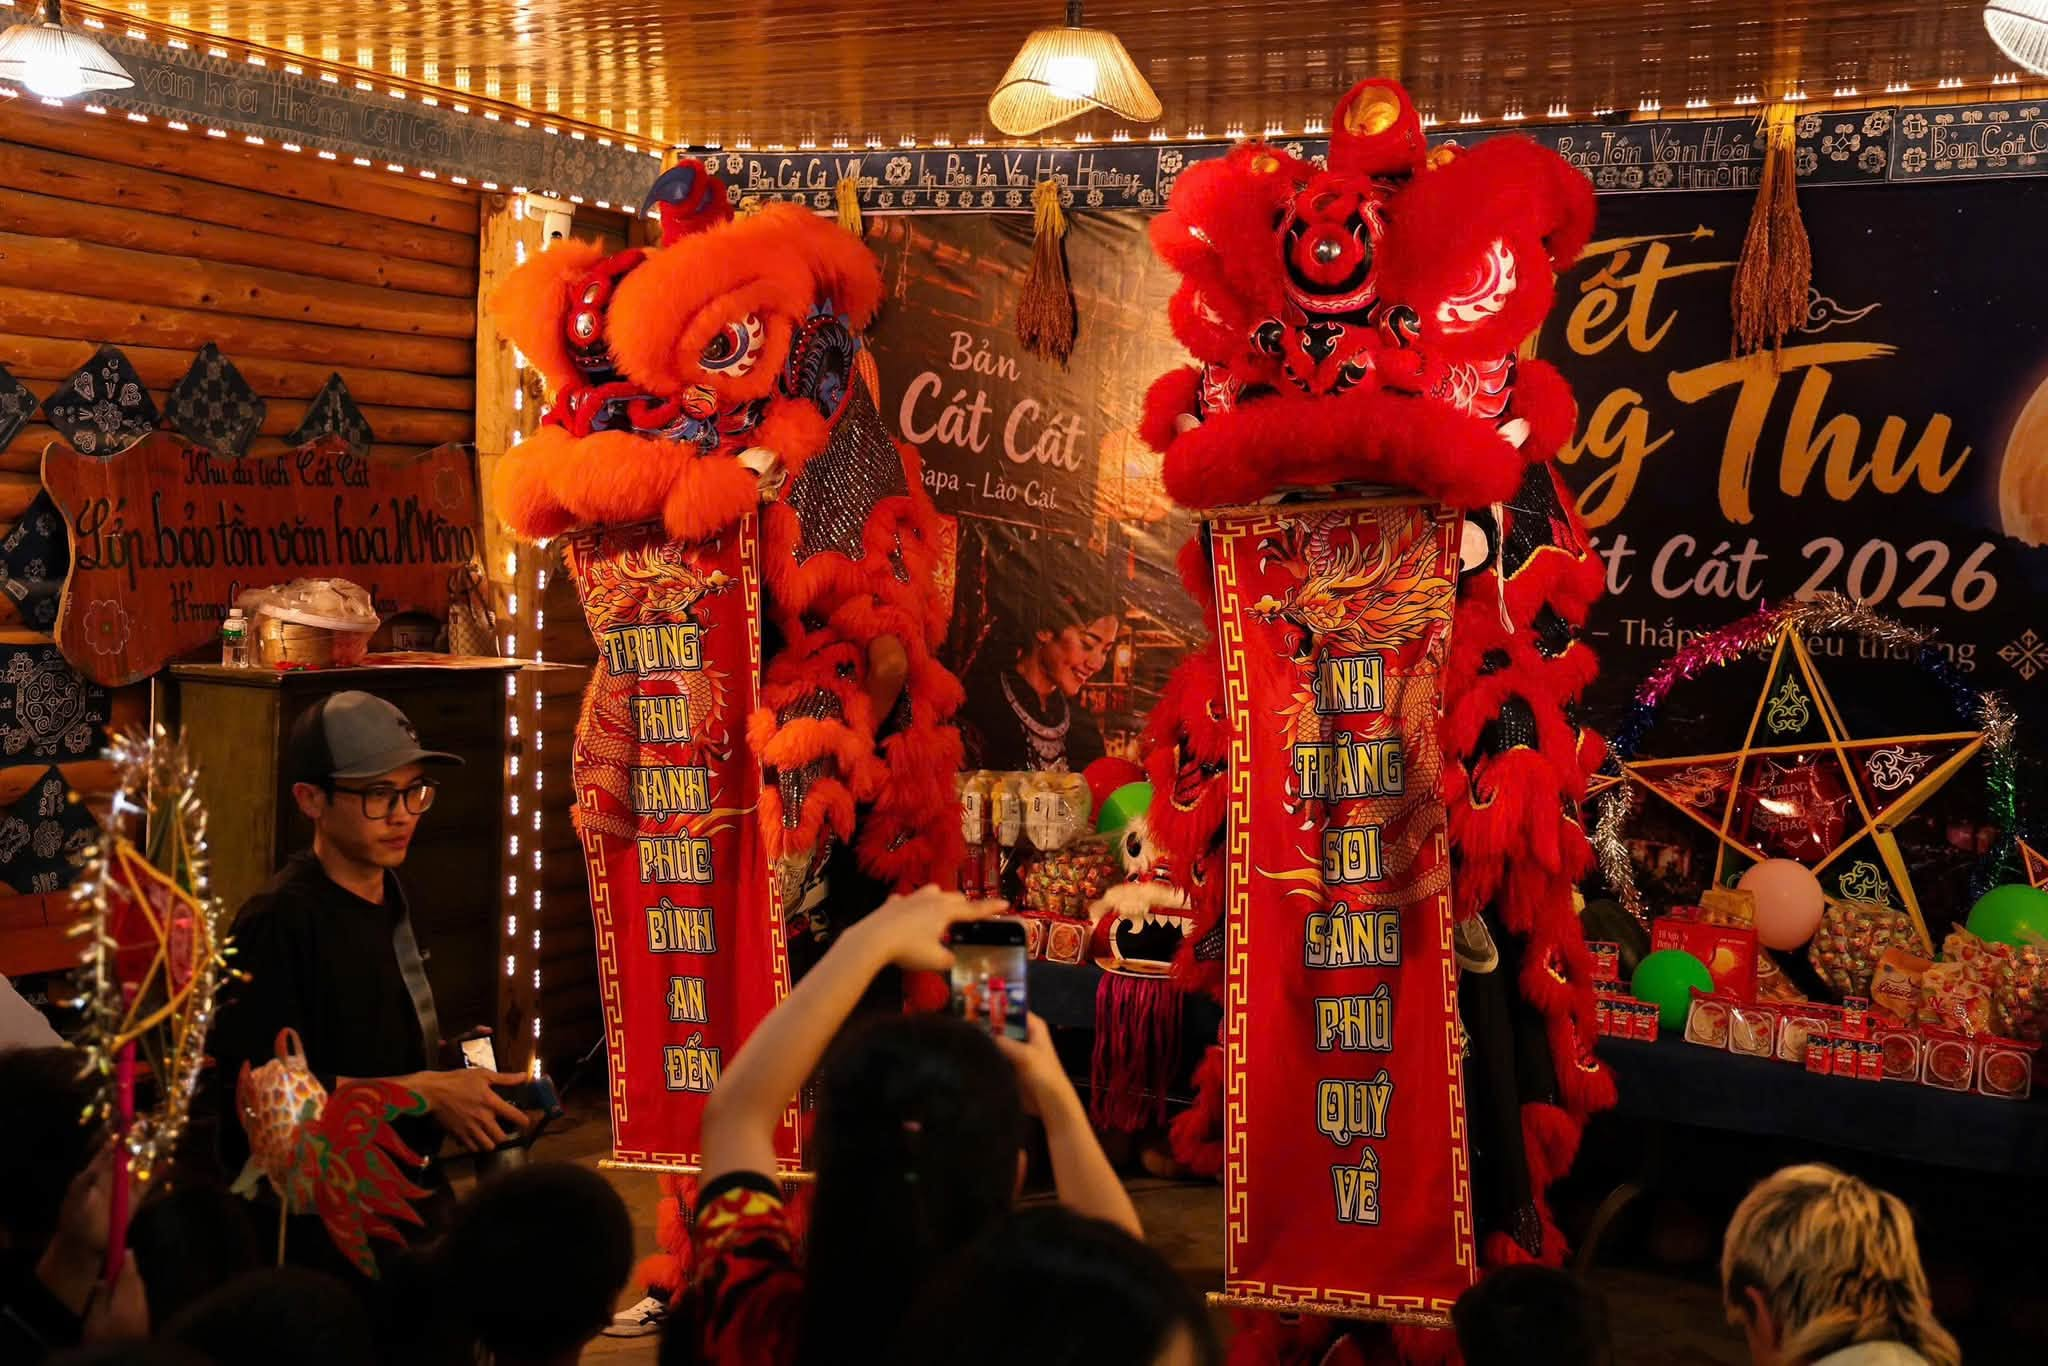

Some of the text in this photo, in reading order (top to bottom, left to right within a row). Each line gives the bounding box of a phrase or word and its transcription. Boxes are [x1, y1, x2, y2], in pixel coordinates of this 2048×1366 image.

[1650, 127, 1697, 163] Văn
[950, 331, 1021, 382] Bản
[900, 371, 1086, 472] Cát Cát
[1668, 342, 1972, 525] Thu
[182, 450, 369, 489] Khu du lịch Cát Cát
[982, 471, 1017, 501] Lào
[1024, 480, 1058, 510] Cai
[76, 496, 147, 592] Lớp
[152, 490, 216, 569] bảo
[216, 500, 266, 568] tồn
[269, 515, 331, 567] văn
[1651, 533, 1768, 600] Cát
[1793, 537, 1998, 612] 2026
[603, 623, 703, 677] TRUNG
[1313, 648, 1384, 713] ÁNH
[631, 694, 691, 742] THU
[631, 766, 712, 824] HẠNH
[1293, 732, 1406, 804] TRĂNG
[637, 826, 714, 884] PHÚC
[645, 896, 717, 954] BÌNH
[1305, 902, 1400, 967] SÁNG
[667, 976, 708, 1023] AN
[1315, 983, 1393, 1051] PHÚ
[664, 1031, 721, 1093] ĐẾN
[1317, 1070, 1393, 1145] QUÝ
[1332, 1147, 1381, 1225] VỀ
